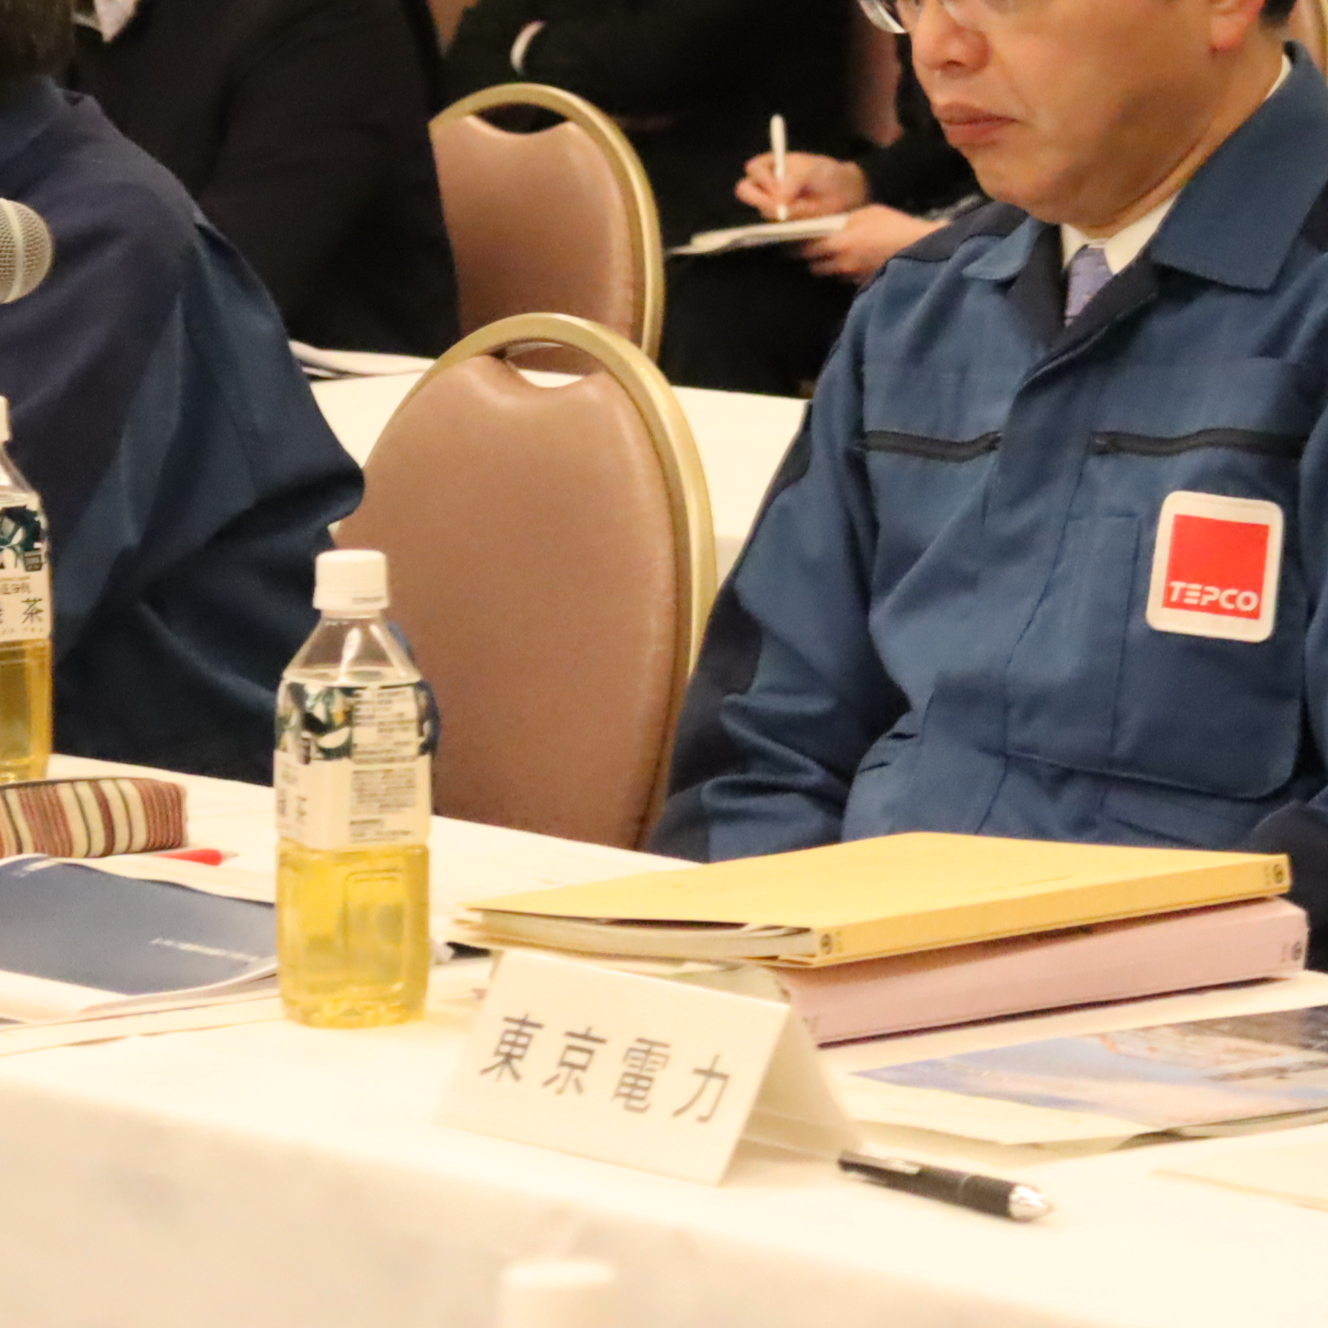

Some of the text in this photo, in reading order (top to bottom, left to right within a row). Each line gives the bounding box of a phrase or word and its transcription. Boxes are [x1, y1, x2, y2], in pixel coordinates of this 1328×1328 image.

[1169, 580, 1260, 612] TEPCO
[479, 1013, 730, 1123] 東京電力
